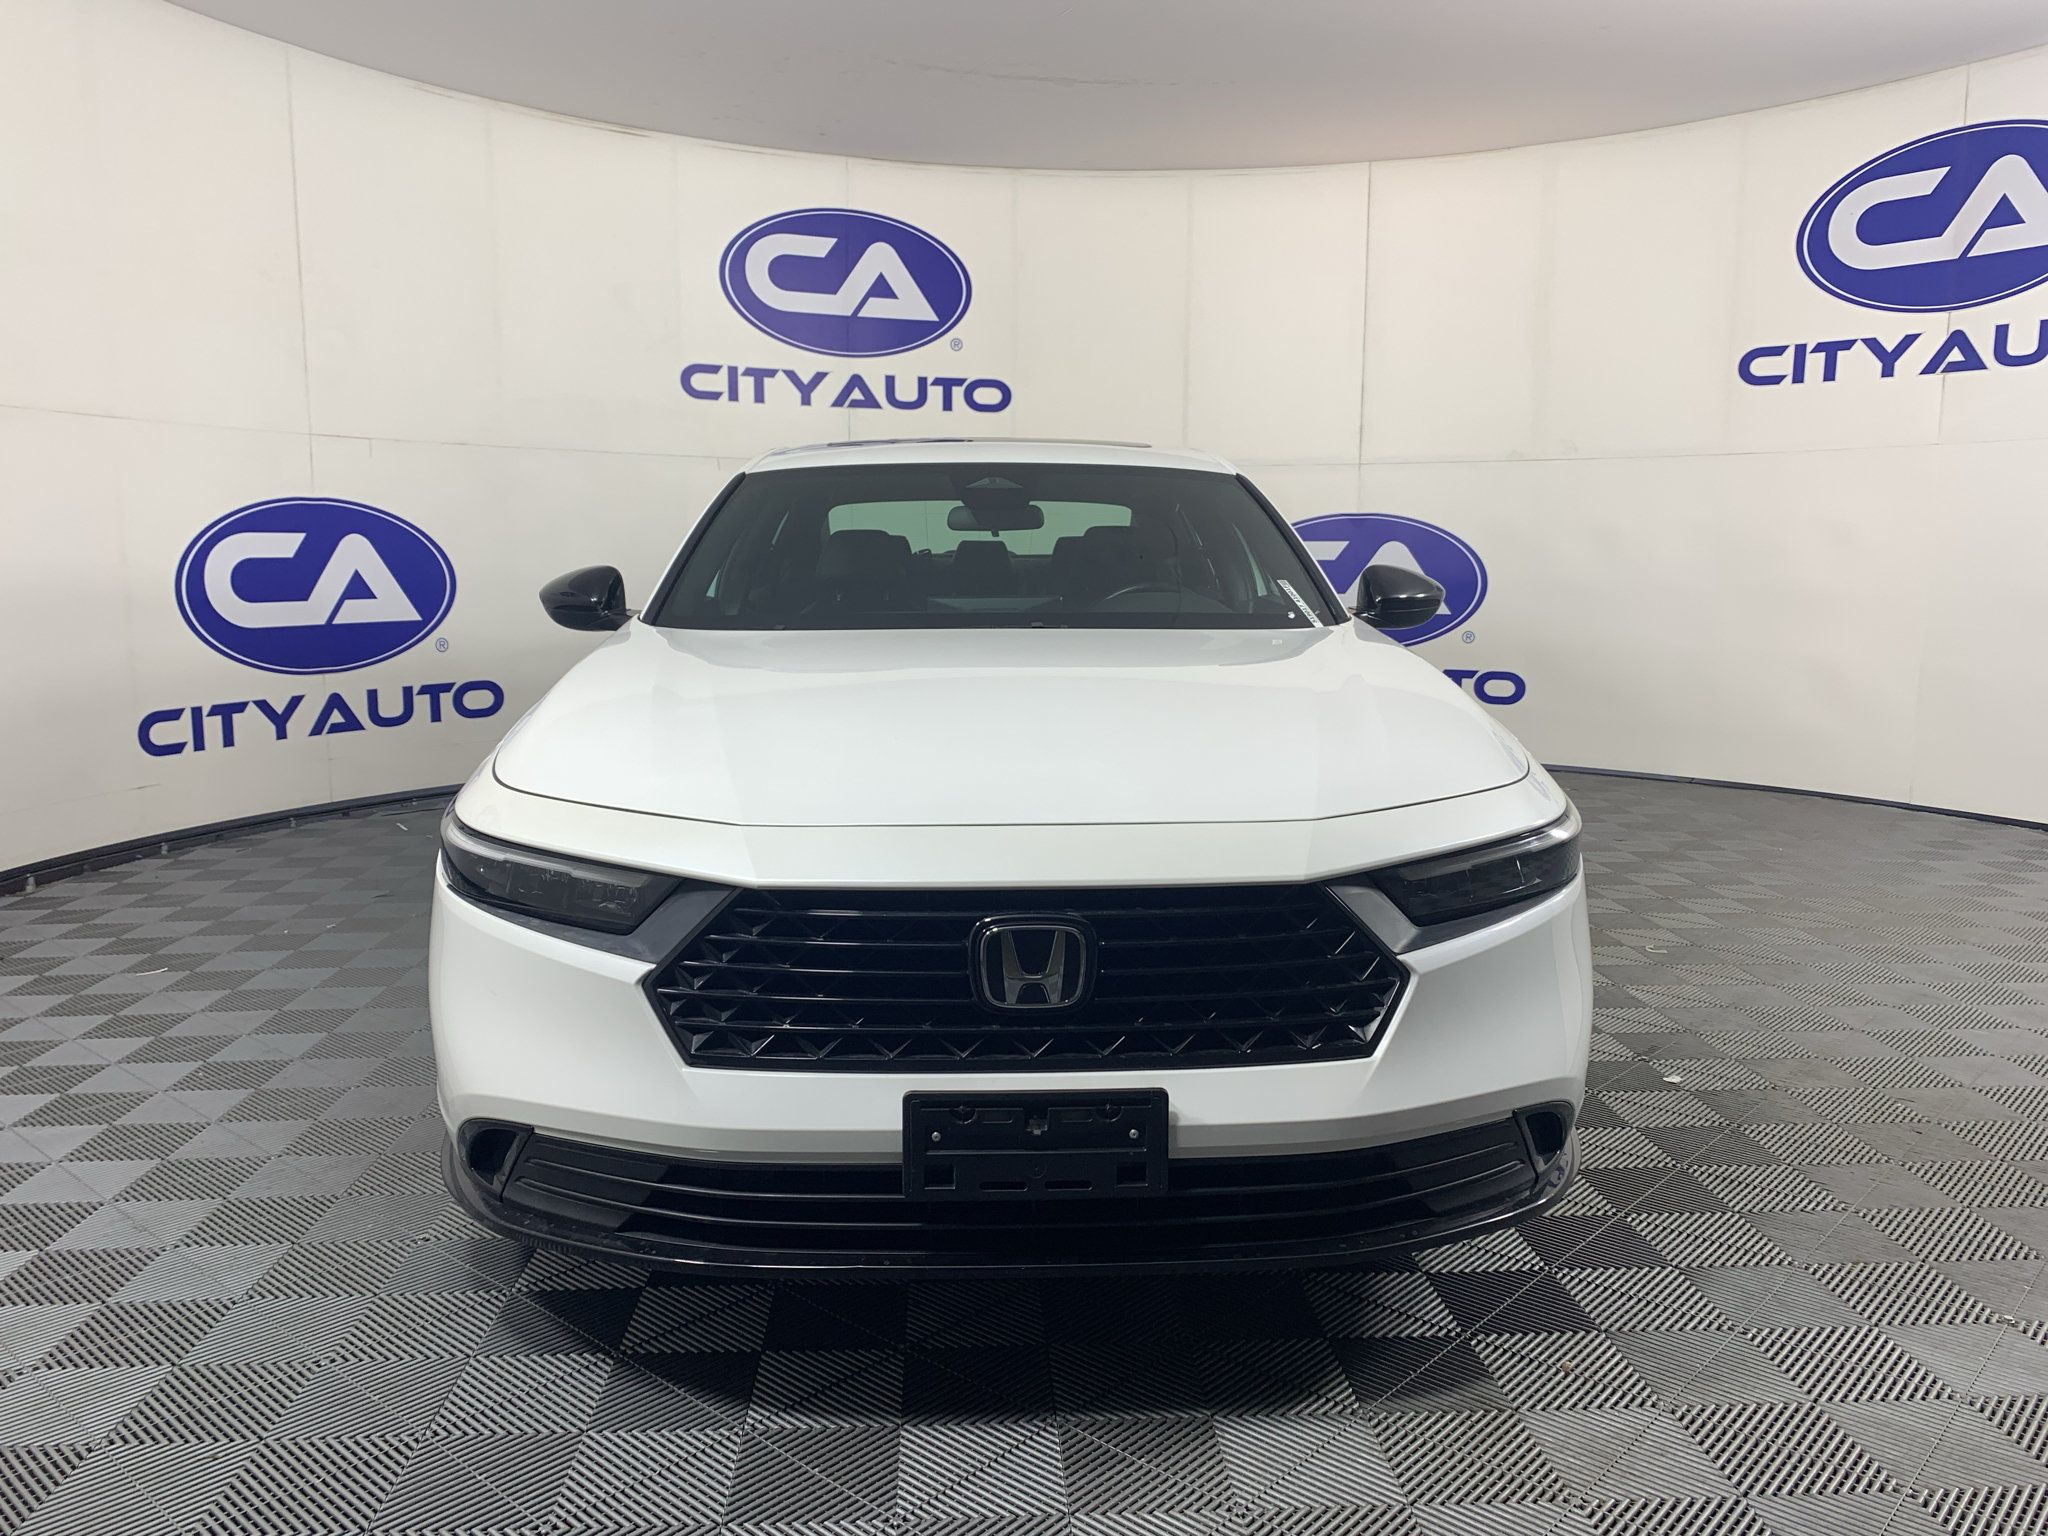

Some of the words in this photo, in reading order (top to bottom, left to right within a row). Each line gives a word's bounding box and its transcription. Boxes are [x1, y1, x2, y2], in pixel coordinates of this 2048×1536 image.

[1828, 154, 2048, 270] CA
[745, 232, 940, 322] CA
[1918, 318, 2048, 376] AU
[203, 531, 423, 629] CA
